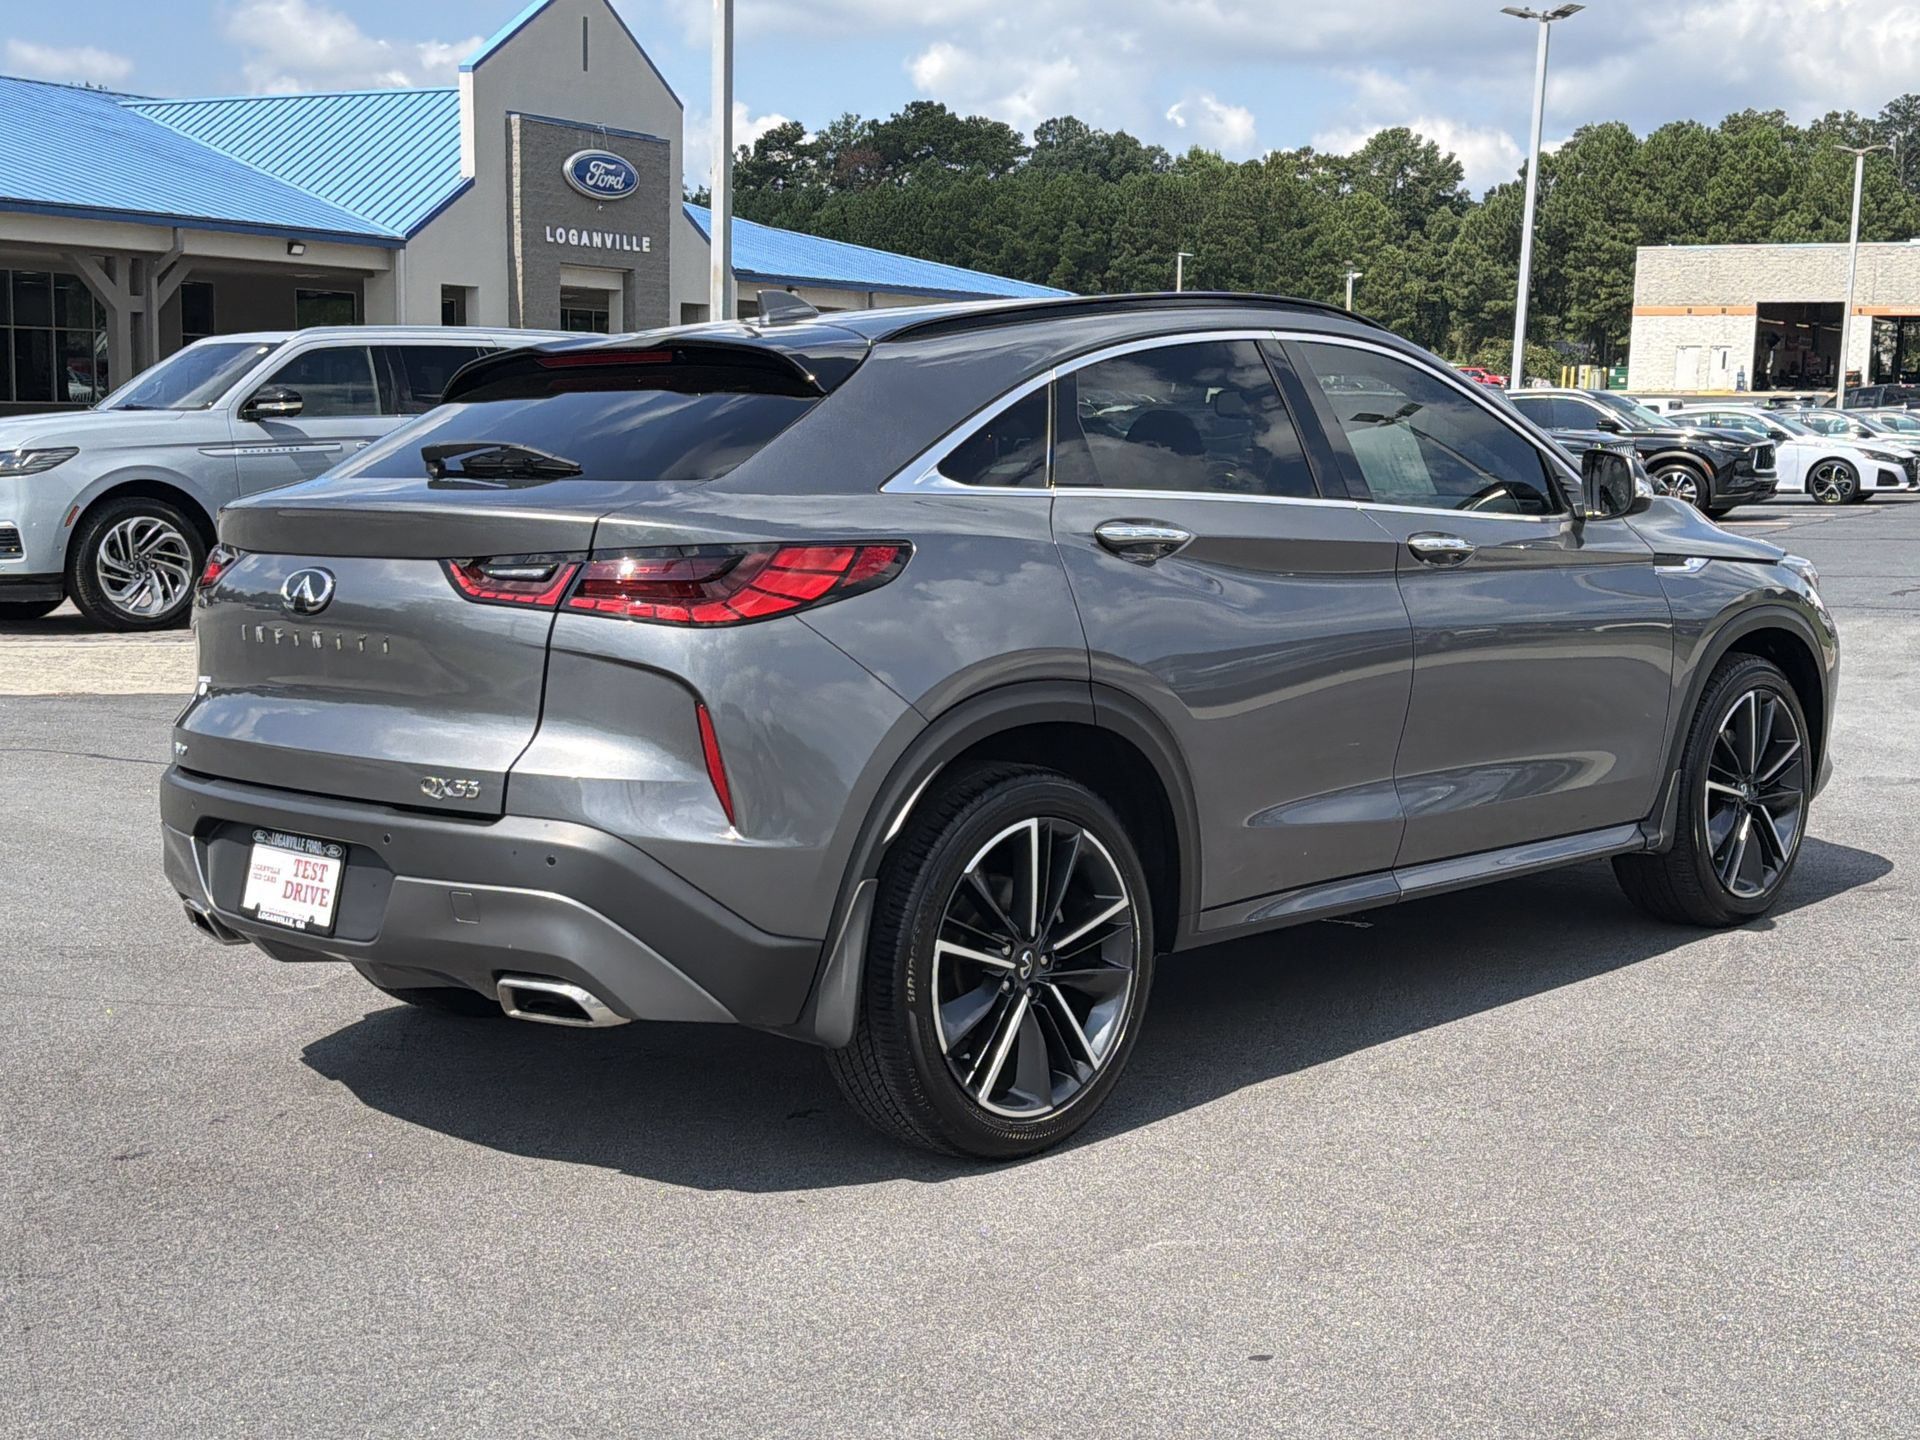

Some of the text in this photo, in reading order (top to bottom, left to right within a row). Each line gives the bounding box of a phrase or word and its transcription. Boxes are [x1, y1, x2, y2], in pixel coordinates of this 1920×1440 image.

[586, 160, 625, 190] Ford
[545, 226, 651, 253] LOGANVILLE
[241, 623, 389, 653] INFINITI
[420, 776, 480, 800] QX55
[271, 832, 323, 855] LOGANVILLE FORD
[294, 859, 328, 882] TEST
[282, 880, 330, 908] DRIVE
